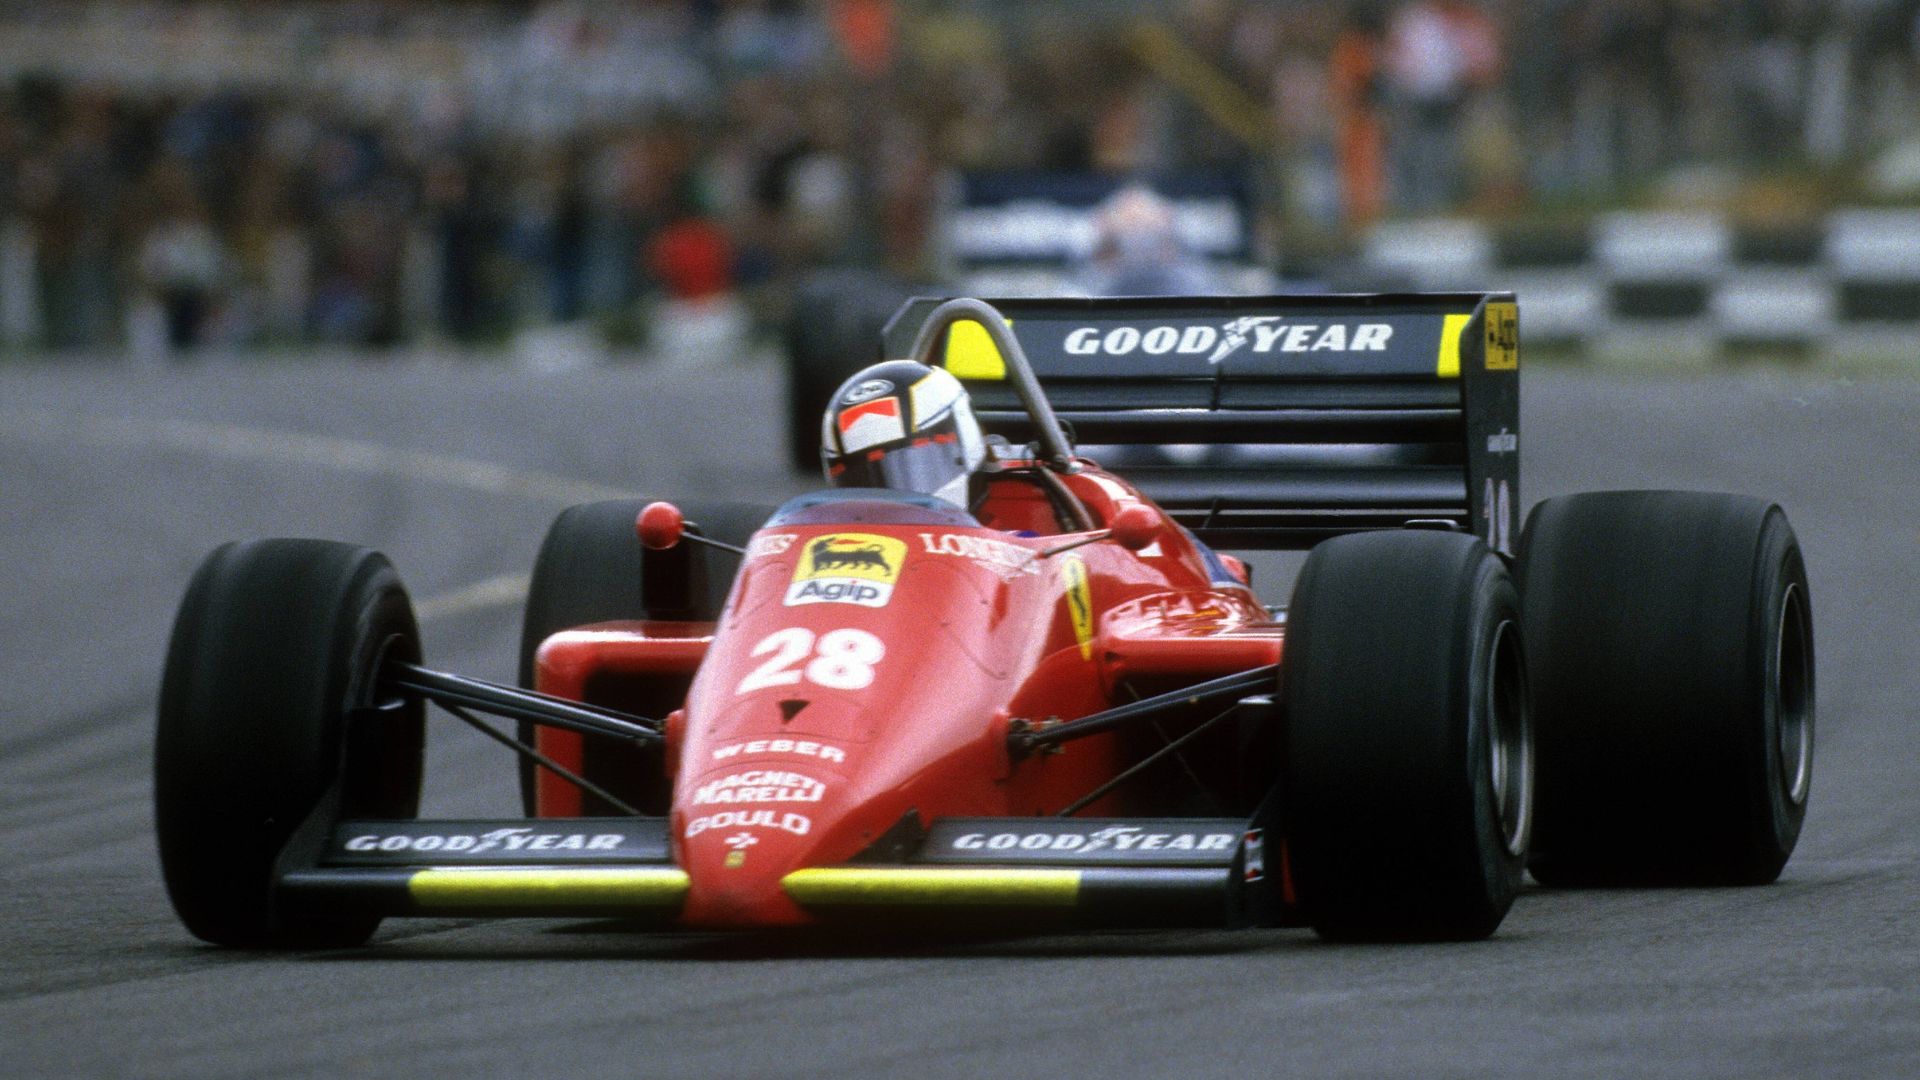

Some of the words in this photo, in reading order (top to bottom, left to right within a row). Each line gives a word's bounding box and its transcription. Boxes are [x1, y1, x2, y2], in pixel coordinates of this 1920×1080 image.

[1064, 322, 1394, 356] GOODYEAR
[795, 580, 879, 601] Agip
[735, 627, 886, 695] 28
[713, 740, 846, 762] WEBER
[685, 810, 811, 838] GOULD
[346, 833, 624, 852] GOODYEAR
[952, 832, 1235, 851] GOODYEAR
